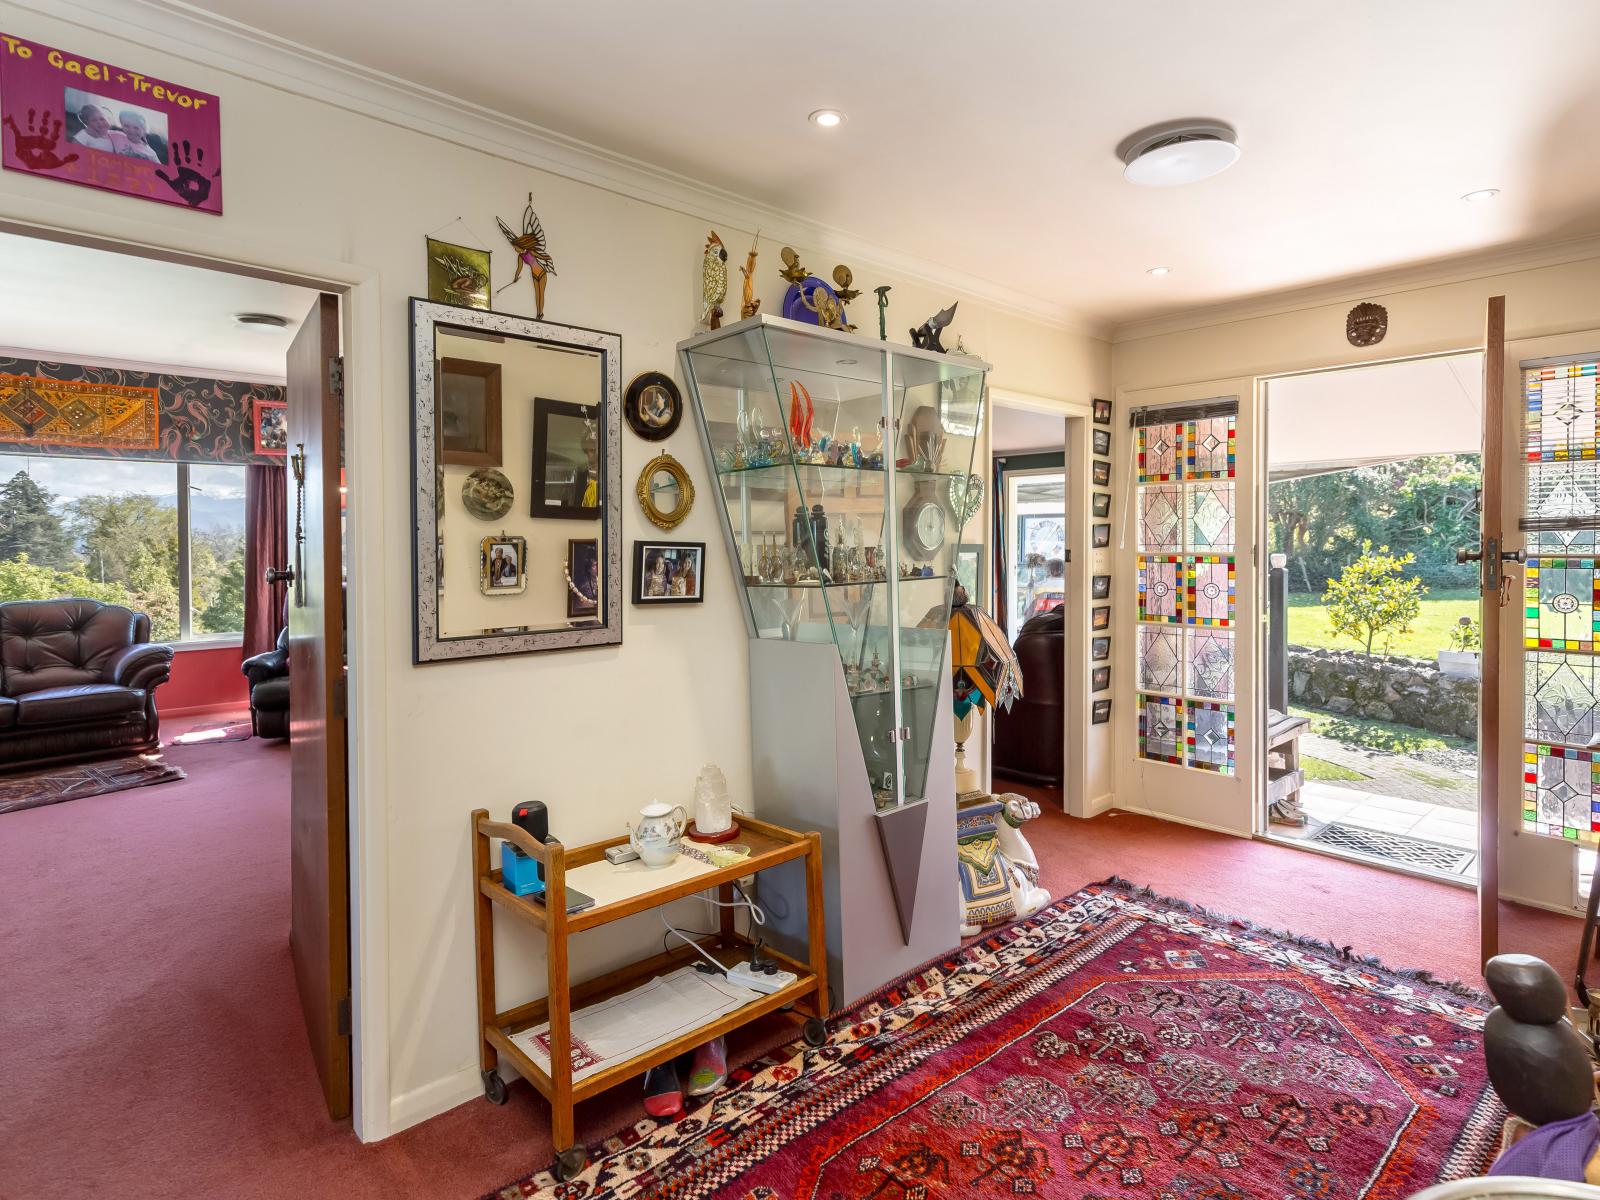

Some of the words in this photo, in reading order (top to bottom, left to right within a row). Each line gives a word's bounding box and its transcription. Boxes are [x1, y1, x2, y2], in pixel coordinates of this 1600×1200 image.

[1, 35, 33, 58] To
[47, 50, 109, 81] Gael
[127, 71, 207, 109] Trevor
